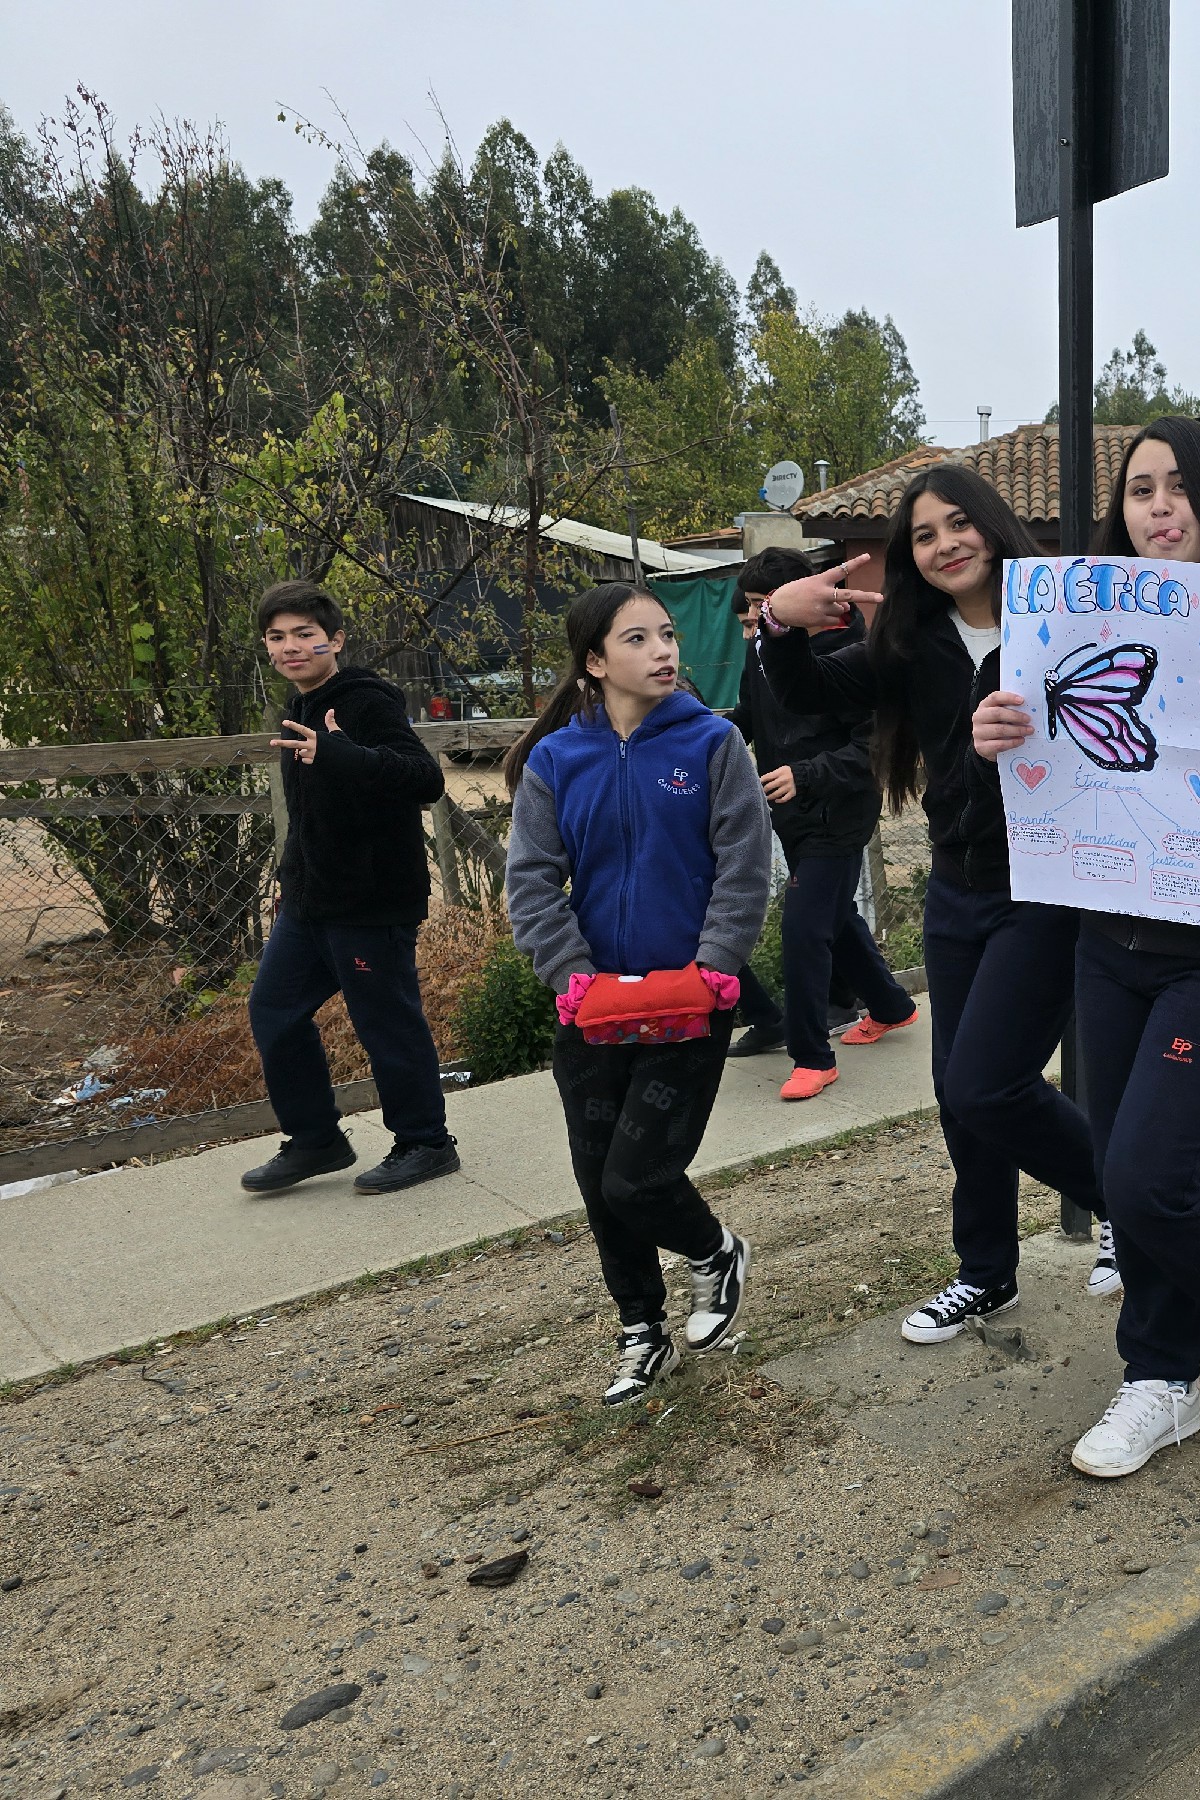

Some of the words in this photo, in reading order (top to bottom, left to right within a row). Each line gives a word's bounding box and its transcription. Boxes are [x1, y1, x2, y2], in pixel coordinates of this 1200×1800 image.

[772, 472, 798, 481] DIRECTV
[1006, 560, 1057, 614] LA
[674, 768, 689, 782] EP
[1007, 811, 1058, 826] Respeto
[1072, 829, 1138, 850] Honestidad
[1146, 851, 1195, 870] Justicia
[1172, 1037, 1193, 1055] EP
[641, 1079, 678, 1111] 66
